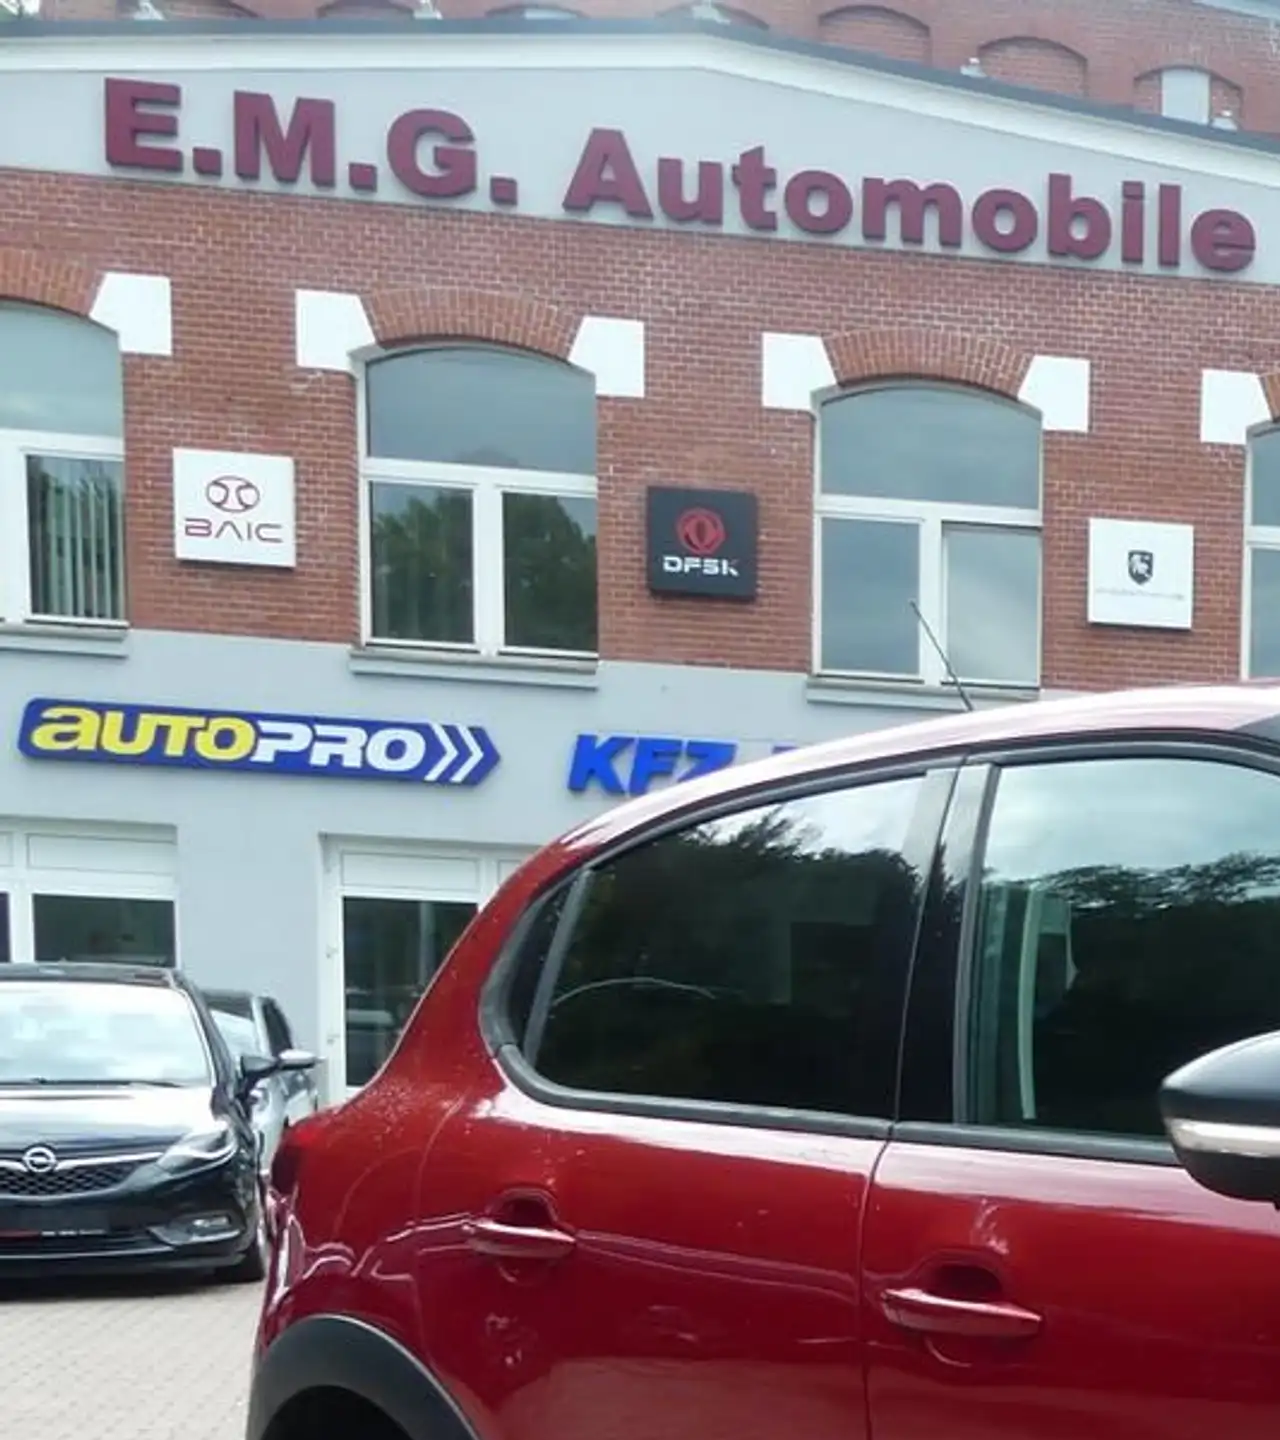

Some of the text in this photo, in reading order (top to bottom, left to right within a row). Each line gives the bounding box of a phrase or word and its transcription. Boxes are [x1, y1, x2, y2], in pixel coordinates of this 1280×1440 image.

[104, 76, 1257, 273] E.M.G. Automobile
[184, 517, 284, 544] BAIC
[662, 555, 740, 577] DFSK
